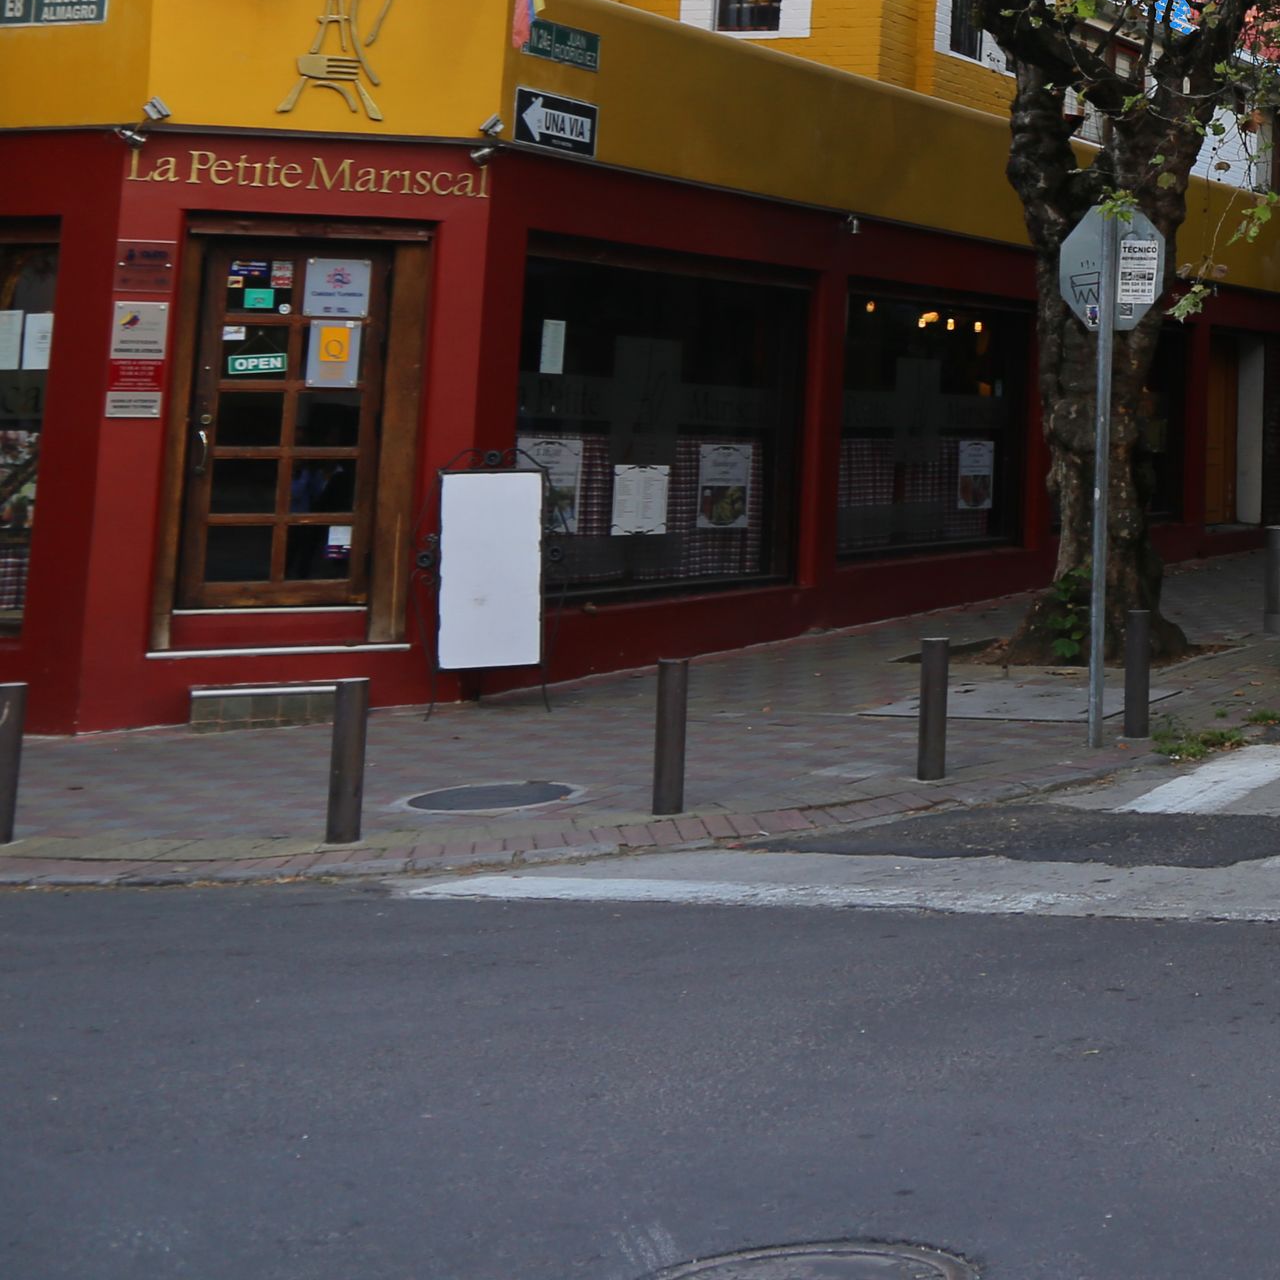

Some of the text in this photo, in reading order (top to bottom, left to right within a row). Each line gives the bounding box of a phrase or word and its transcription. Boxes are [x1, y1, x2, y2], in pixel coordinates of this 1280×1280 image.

[41, 5, 97, 20] ALMAGRO
[567, 31, 587, 50] JUAN
[544, 111, 585, 140] UNA VIA
[126, 148, 489, 198] La Petite Mariscal
[234, 357, 282, 371] OPEN
